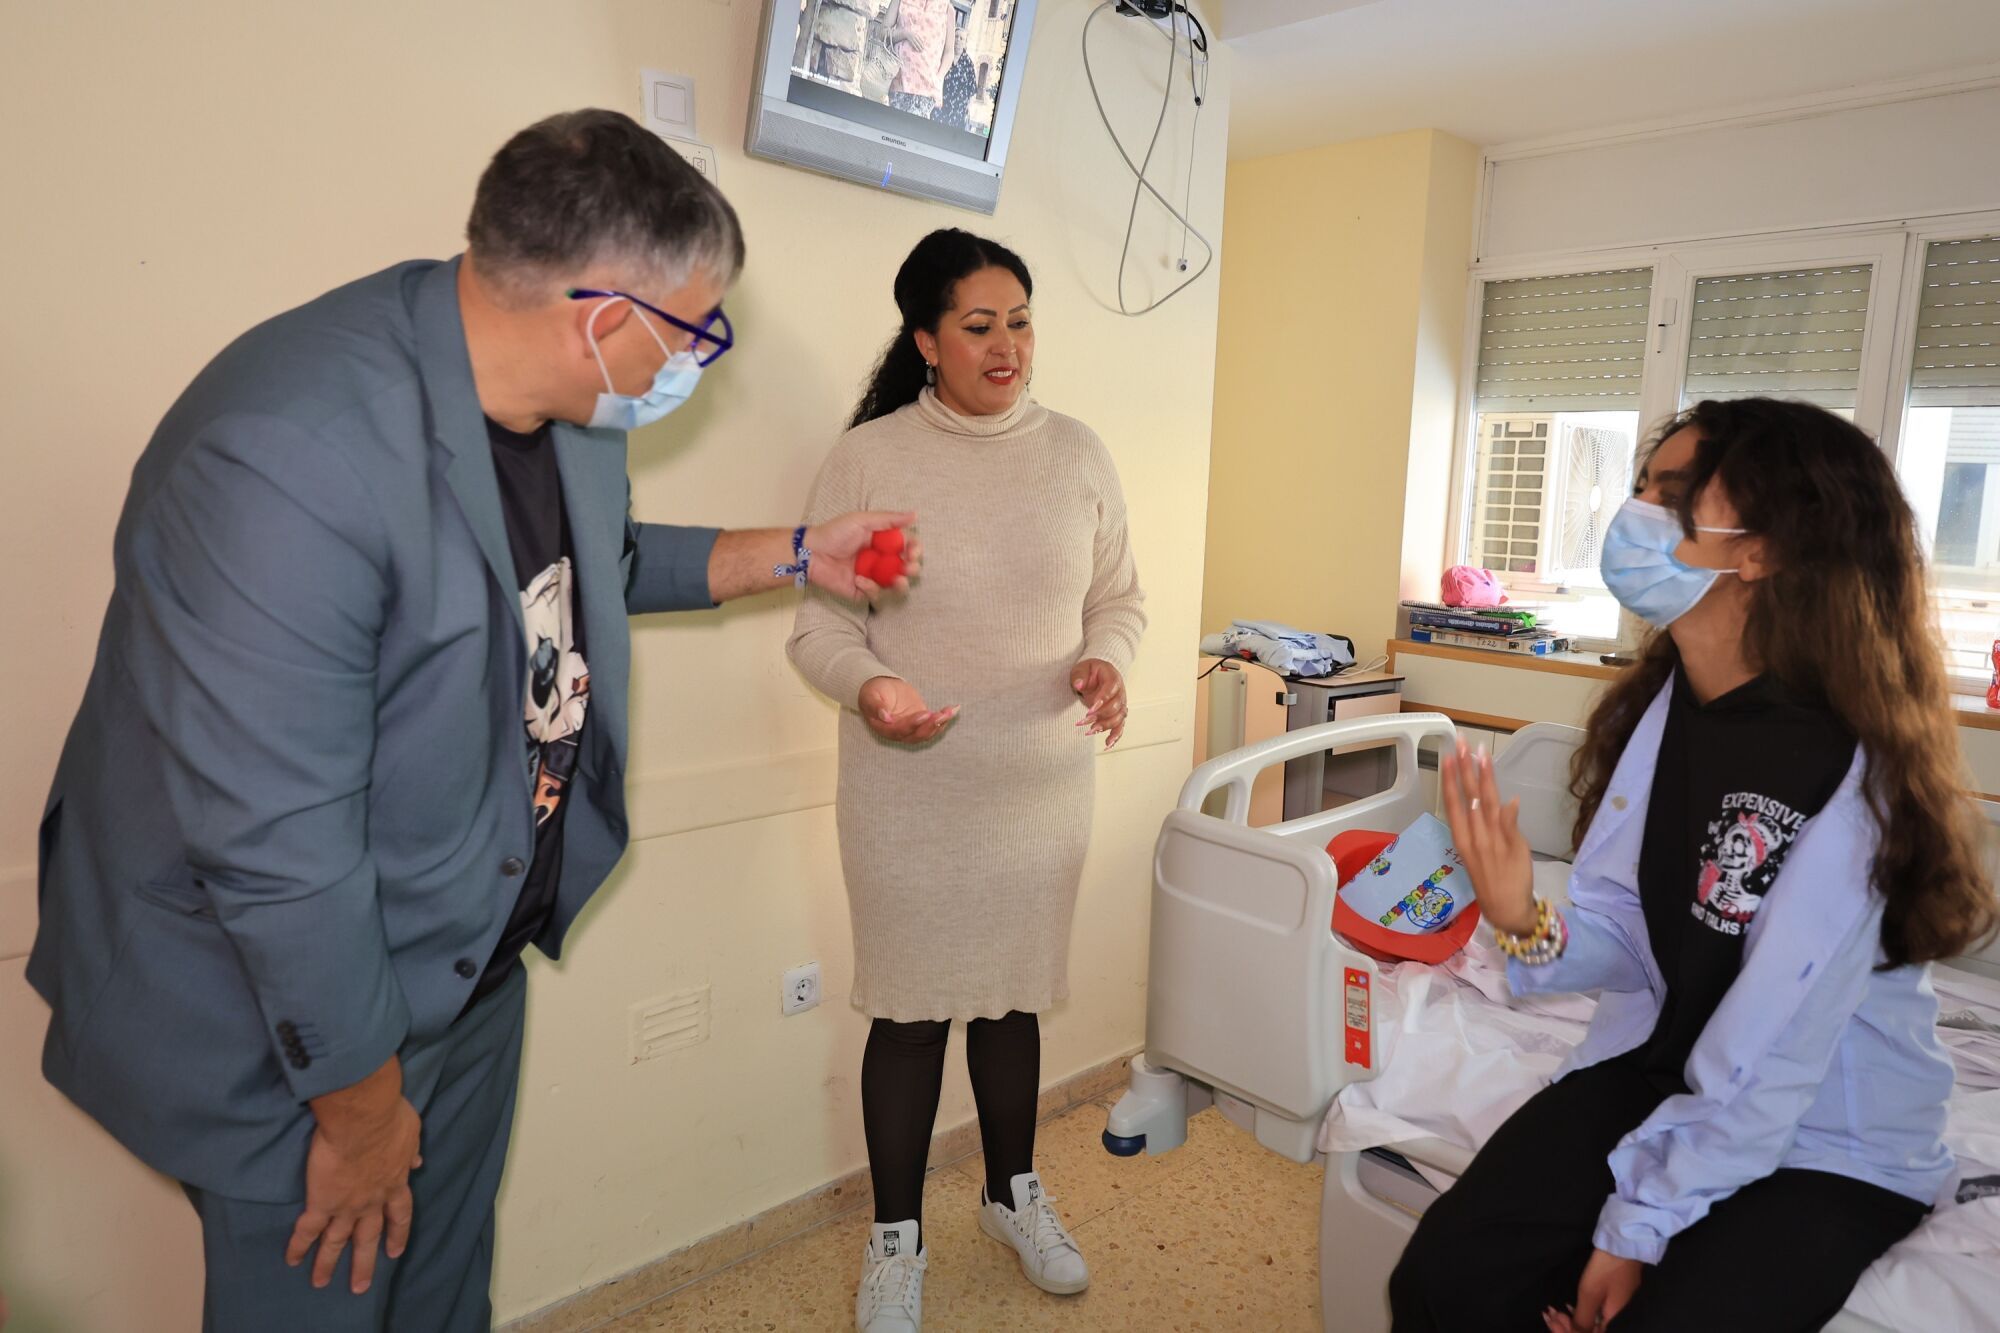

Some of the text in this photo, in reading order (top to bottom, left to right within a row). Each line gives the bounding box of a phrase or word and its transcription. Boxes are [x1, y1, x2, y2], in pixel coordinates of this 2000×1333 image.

[881, 135, 907, 147] GRUNDIG
[1721, 791, 1807, 830] EXPENSIVE
[1704, 911, 1741, 936] TALKS
